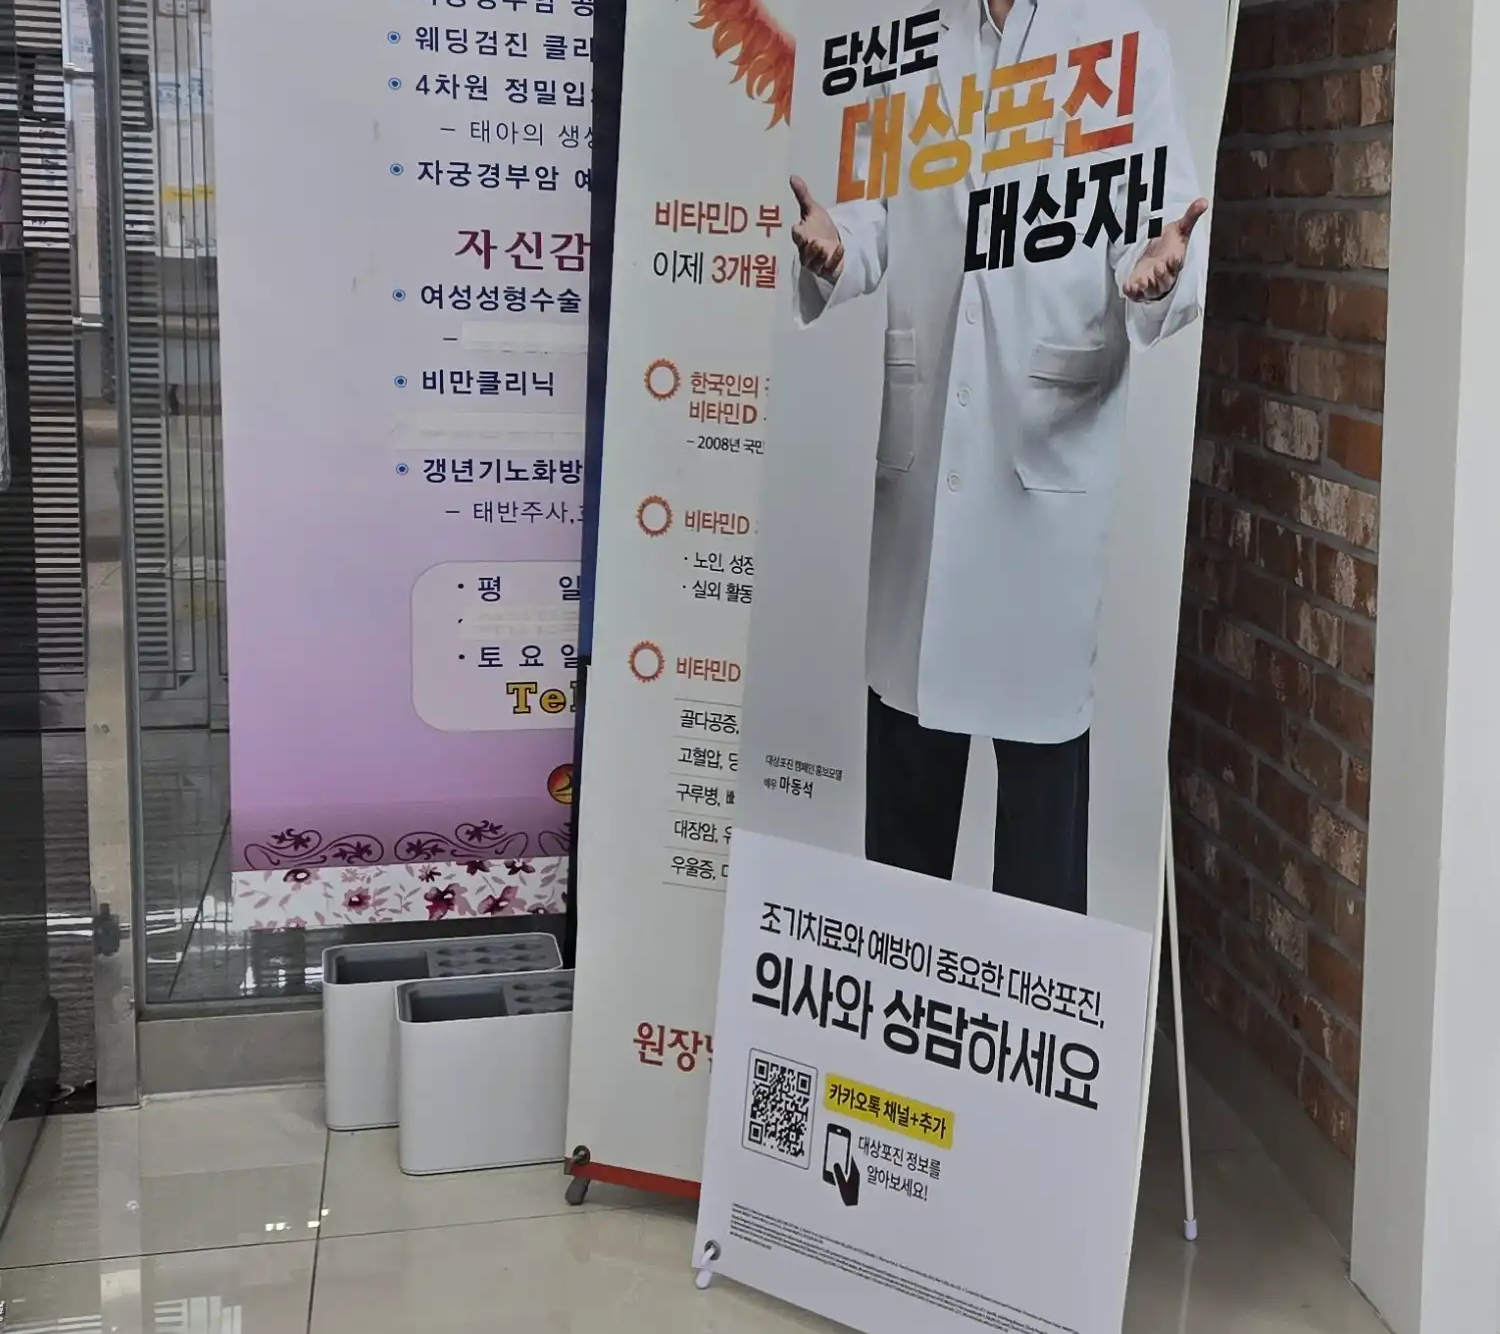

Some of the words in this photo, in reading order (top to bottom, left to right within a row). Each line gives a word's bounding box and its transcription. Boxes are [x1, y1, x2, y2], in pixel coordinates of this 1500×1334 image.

[415, 26, 528, 58] 웨딩검진
[821, 9, 941, 96] 당신도
[415, 74, 488, 101] 4차원
[505, 78, 594, 107] 정밀입
[836, 30, 1140, 204] 대상포진
[470, 120, 543, 147] 태아의
[417, 160, 560, 191] 자궁경부암
[654, 199, 748, 235] 비타민D
[755, 204, 783, 238] 부
[964, 145, 1169, 273] 대상자!
[455, 229, 591, 272] 자신감
[653, 250, 704, 285] 이제
[711, 253, 777, 289] 3개월
[421, 284, 582, 313] 여성성형수술
[422, 369, 554, 397] 비만클리닉
[690, 371, 759, 398] 한국인의
[689, 400, 758, 425] 비타민D
[697, 436, 741, 452] 2008년
[423, 458, 583, 484] 갱년기노화방
[684, 509, 750, 535] 비타민D
[692, 579, 721, 601] 실외
[725, 582, 753, 604] 활동
[676, 656, 741, 682] 비타민D
[680, 709, 740, 735] 골다공증,
[678, 747, 723, 770] 고혈압,
[765, 754, 794, 771] 대상포진
[676, 783, 721, 807] 구루병,
[779, 776, 814, 799] 마동석
[671, 855, 716, 881] 우울증,
[759, 901, 865, 958] 조기치료와
[868, 929, 933, 977] 예방이
[936, 948, 1004, 998] 중요한
[752, 952, 874, 1040] 의사와
[883, 988, 1101, 1111] 상담하세요
[829, 1083, 881, 1119] 카카오톡
[883, 1100, 947, 1140] 채널+추가
[858, 1136, 904, 1167] 대상포진
[906, 1151, 941, 1180] 정보를
[867, 1165, 929, 1202] 알아보세요!
